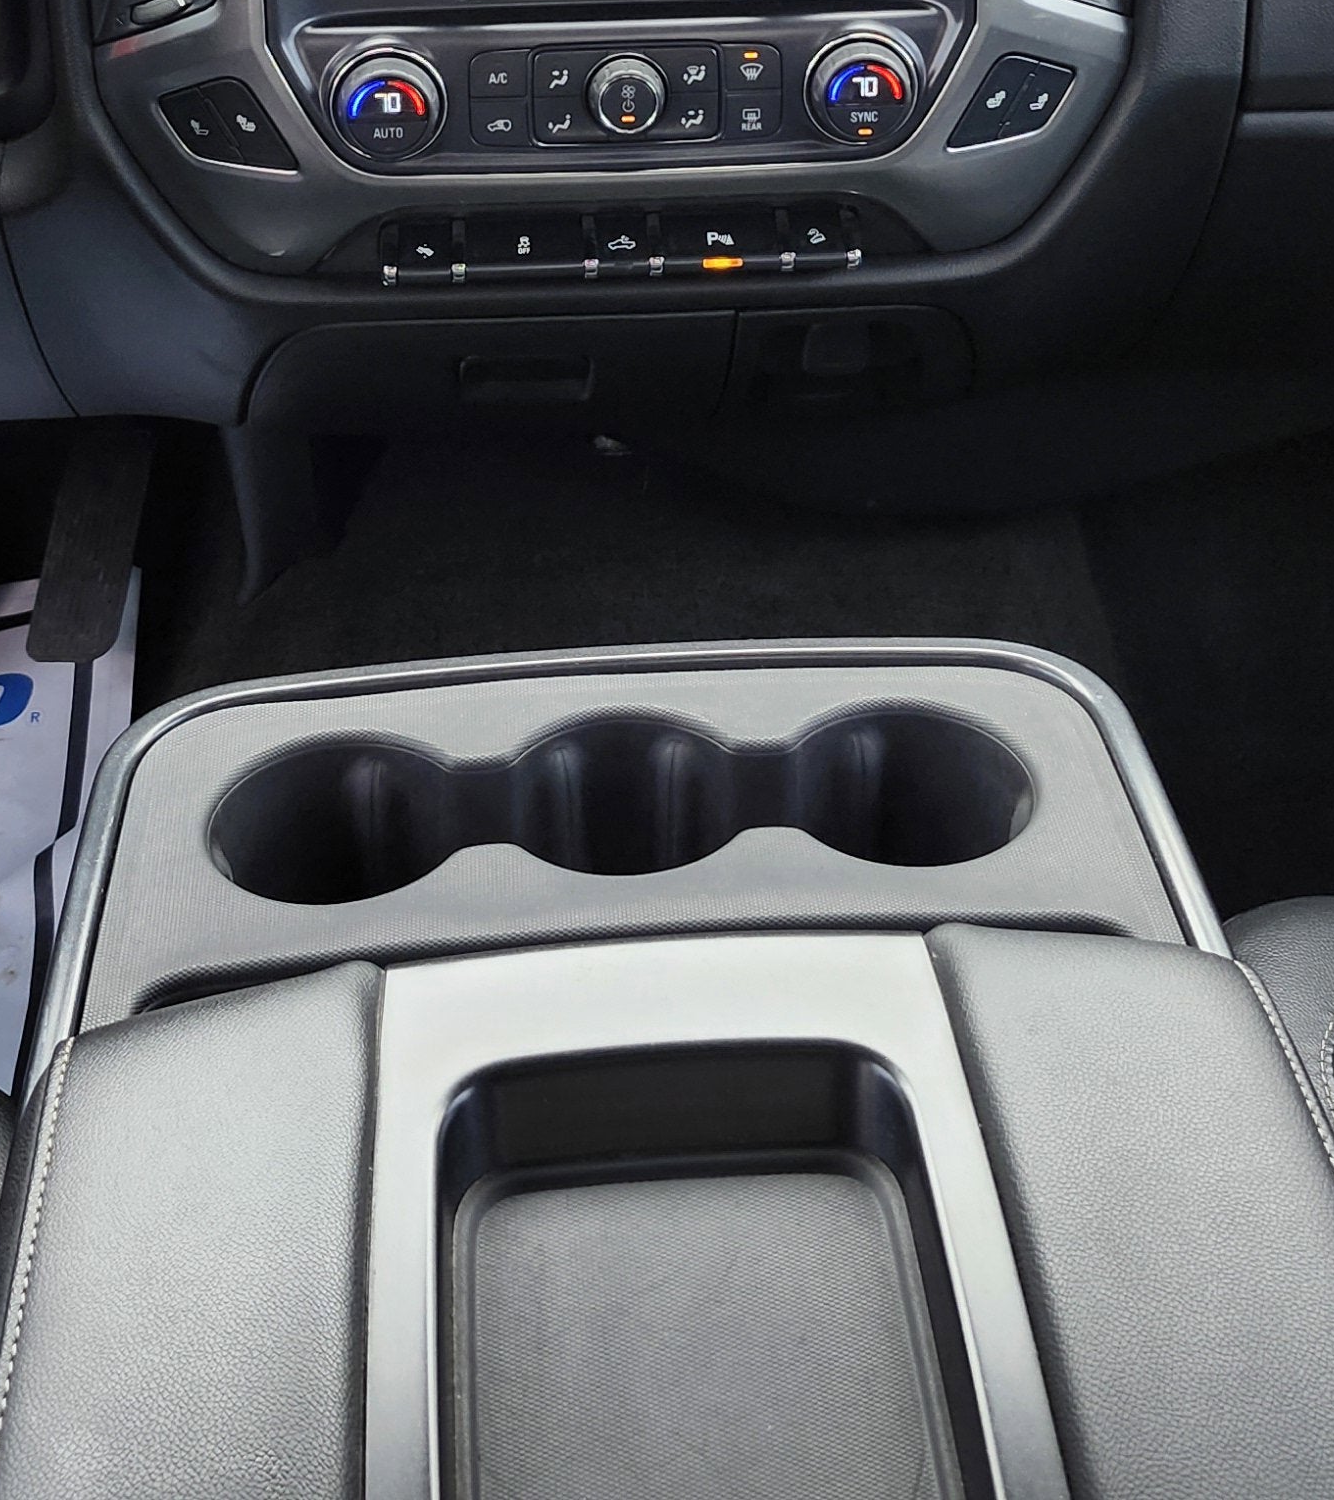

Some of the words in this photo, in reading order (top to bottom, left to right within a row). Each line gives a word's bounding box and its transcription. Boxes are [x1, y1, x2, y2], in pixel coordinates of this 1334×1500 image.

[488, 72, 508, 85] A/C
[852, 76, 879, 97] 70
[374, 92, 402, 113] 70
[850, 111, 879, 123] SYNC
[741, 122, 763, 131] REAR
[373, 127, 404, 139] AUTO
[707, 232, 719, 246] P
[517, 247, 531, 255] OFF
